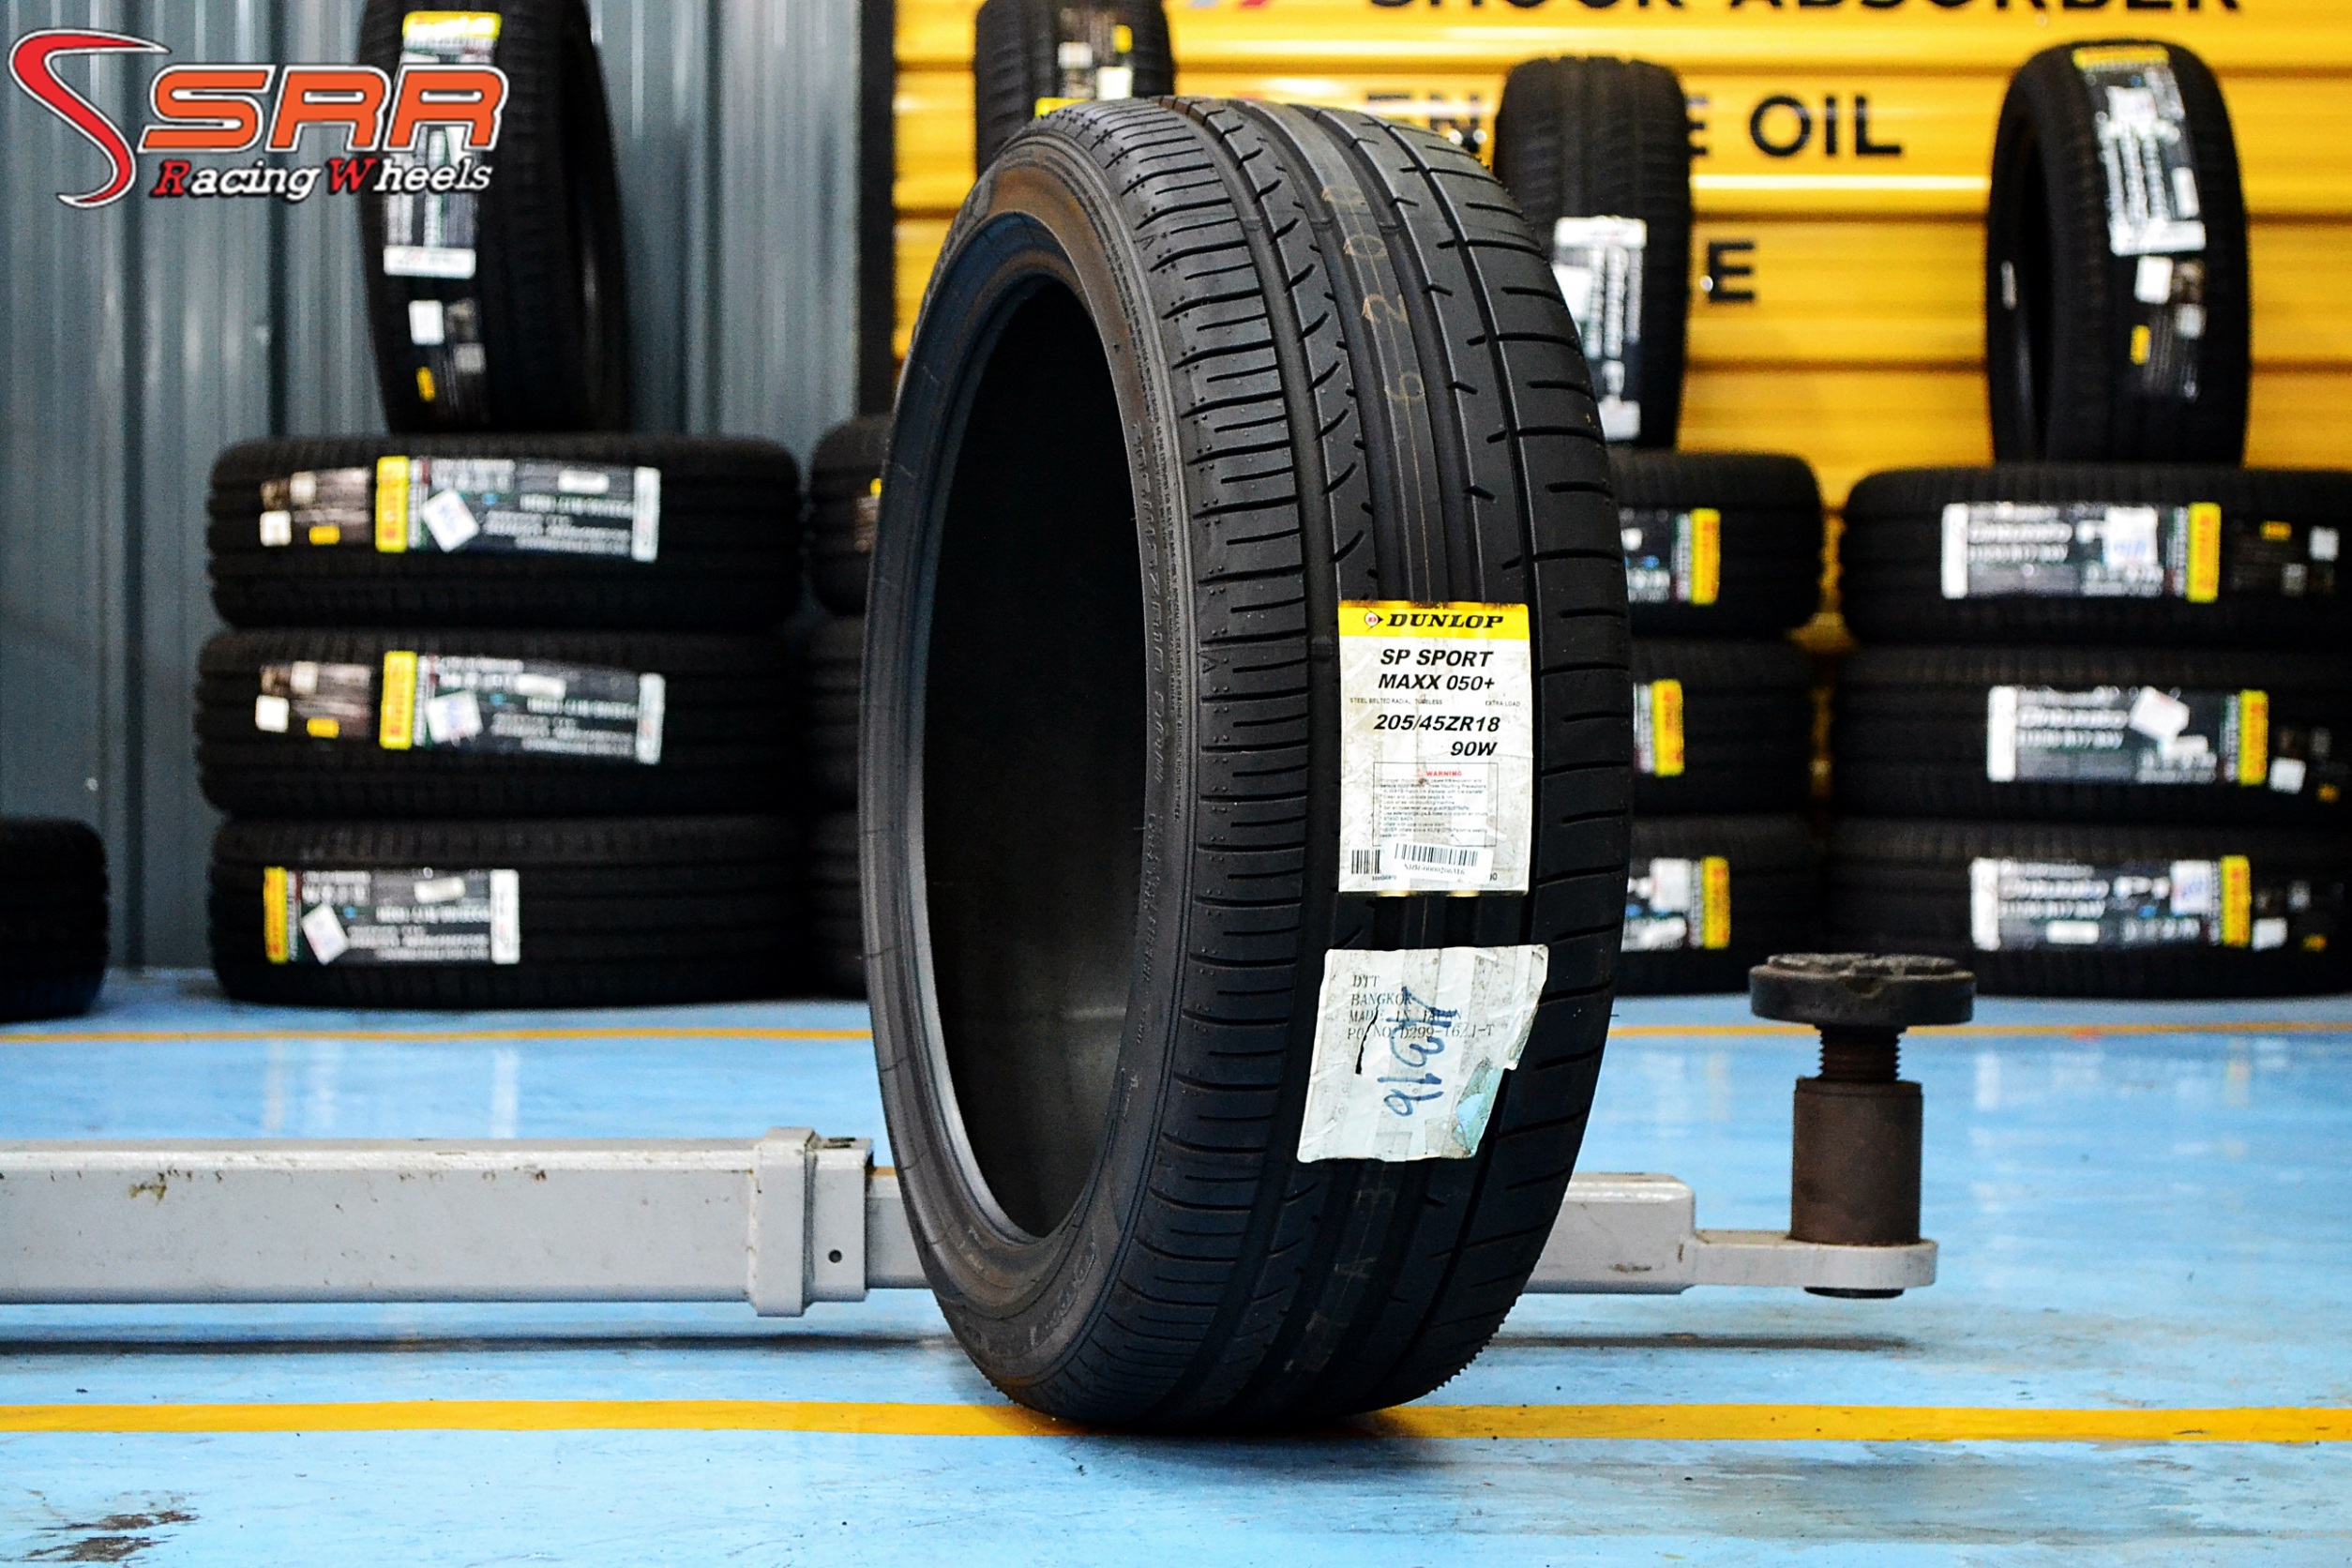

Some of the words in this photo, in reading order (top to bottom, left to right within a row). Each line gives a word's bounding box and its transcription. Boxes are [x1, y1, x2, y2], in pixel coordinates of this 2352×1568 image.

[1749, 95, 1903, 158] OIL
[1386, 613, 1504, 628] DUNLOP
[1380, 648, 1410, 665] SP
[1416, 649, 1494, 667] SPORT
[1378, 673, 1442, 689] MAXX
[1446, 675, 1495, 691] 050+
[1374, 714, 1500, 732] 205/45ZR18
[1451, 741, 1498, 756] 90W
[1352, 975, 1380, 988] DTT
[1351, 992, 1412, 1006] BANGKOK
